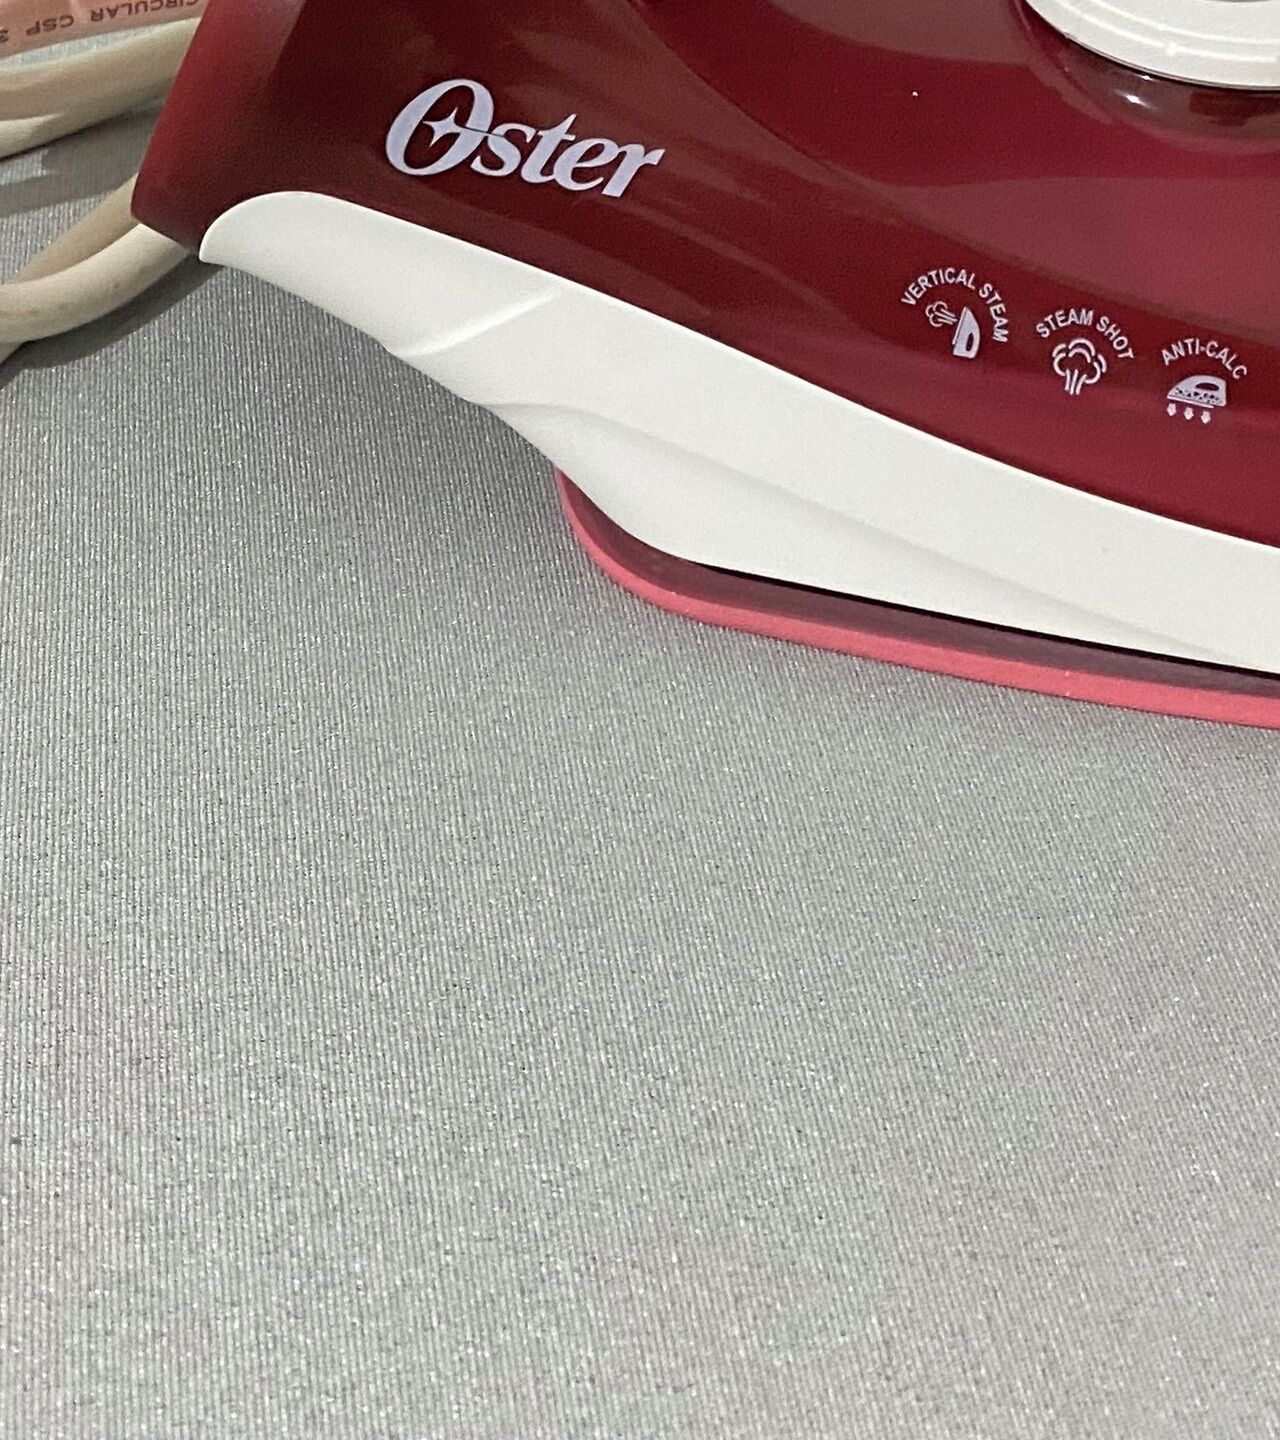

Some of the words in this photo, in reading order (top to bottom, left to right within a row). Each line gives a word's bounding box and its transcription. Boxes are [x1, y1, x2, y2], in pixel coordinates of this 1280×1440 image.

[26, 14, 75, 37] CSP
[385, 79, 666, 197] Oster
[901, 266, 976, 307] VERTICAL
[978, 283, 1009, 343] STEAM
[1036, 308, 1094, 339] STEAM
[1096, 316, 1135, 361] SHOT
[1161, 337, 1248, 380] ANTI-CALC
